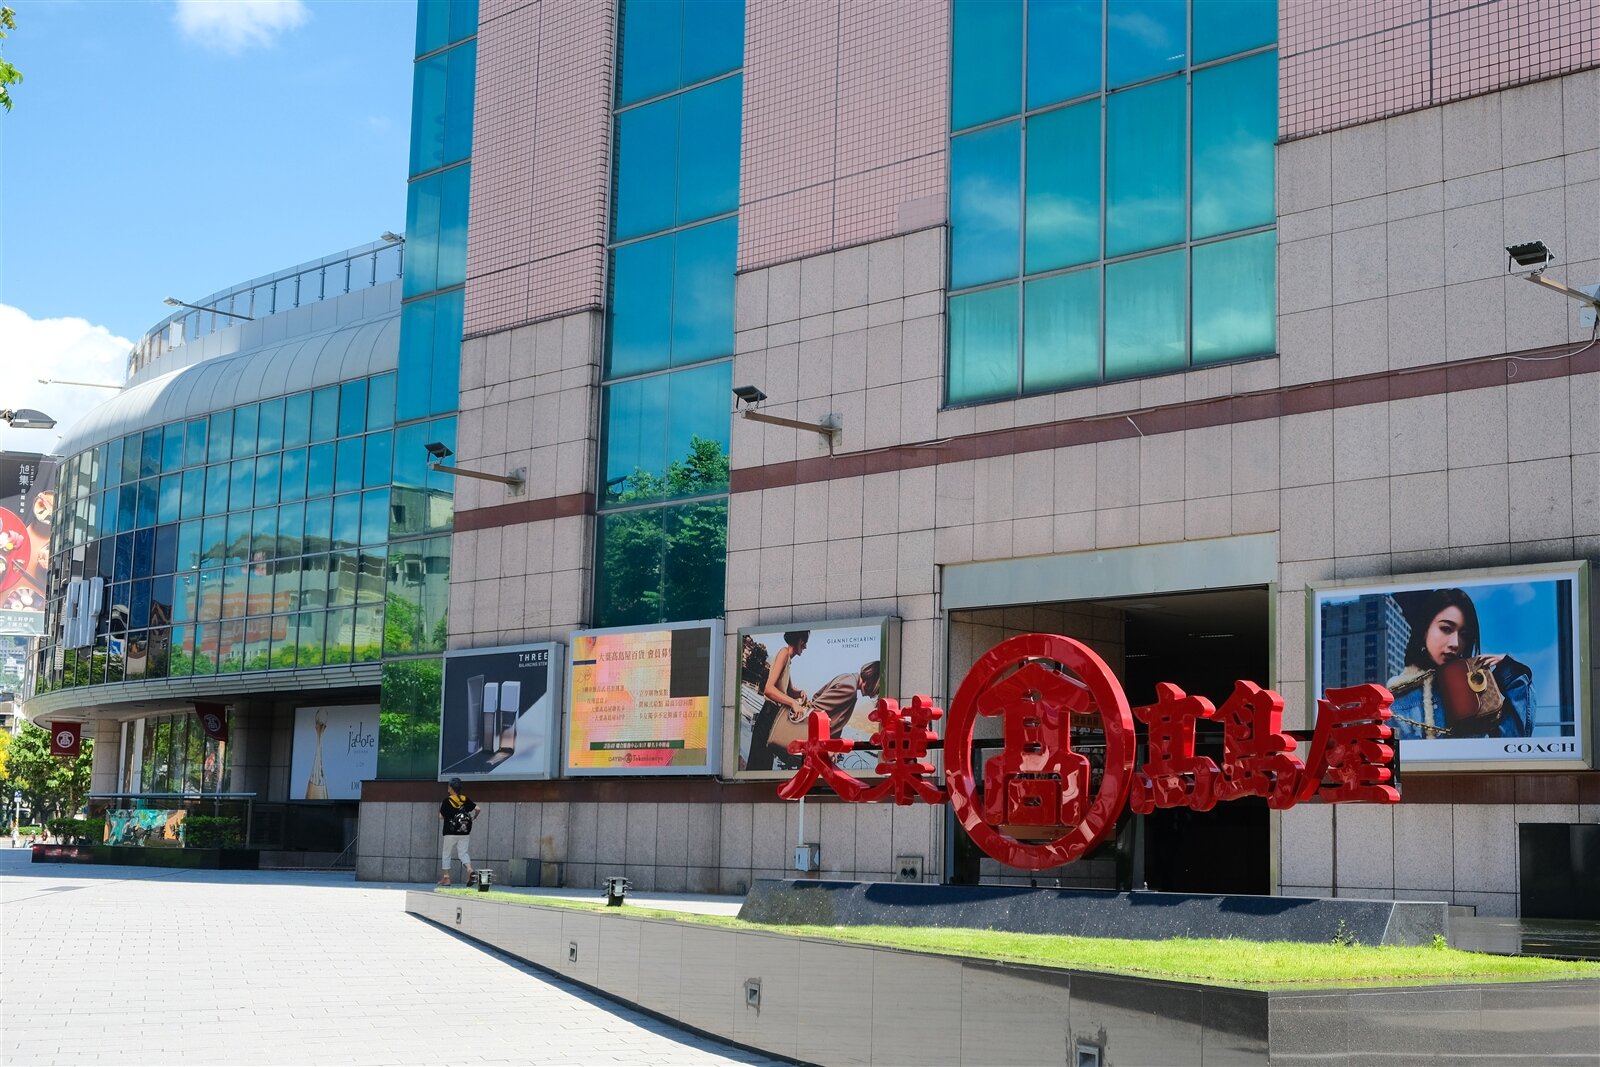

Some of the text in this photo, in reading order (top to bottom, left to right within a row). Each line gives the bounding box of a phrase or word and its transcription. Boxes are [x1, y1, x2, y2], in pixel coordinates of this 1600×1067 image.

[19, 464, 30, 486] 旭集
[519, 652, 548, 662] THREE
[1504, 743, 1576, 753] COACH
